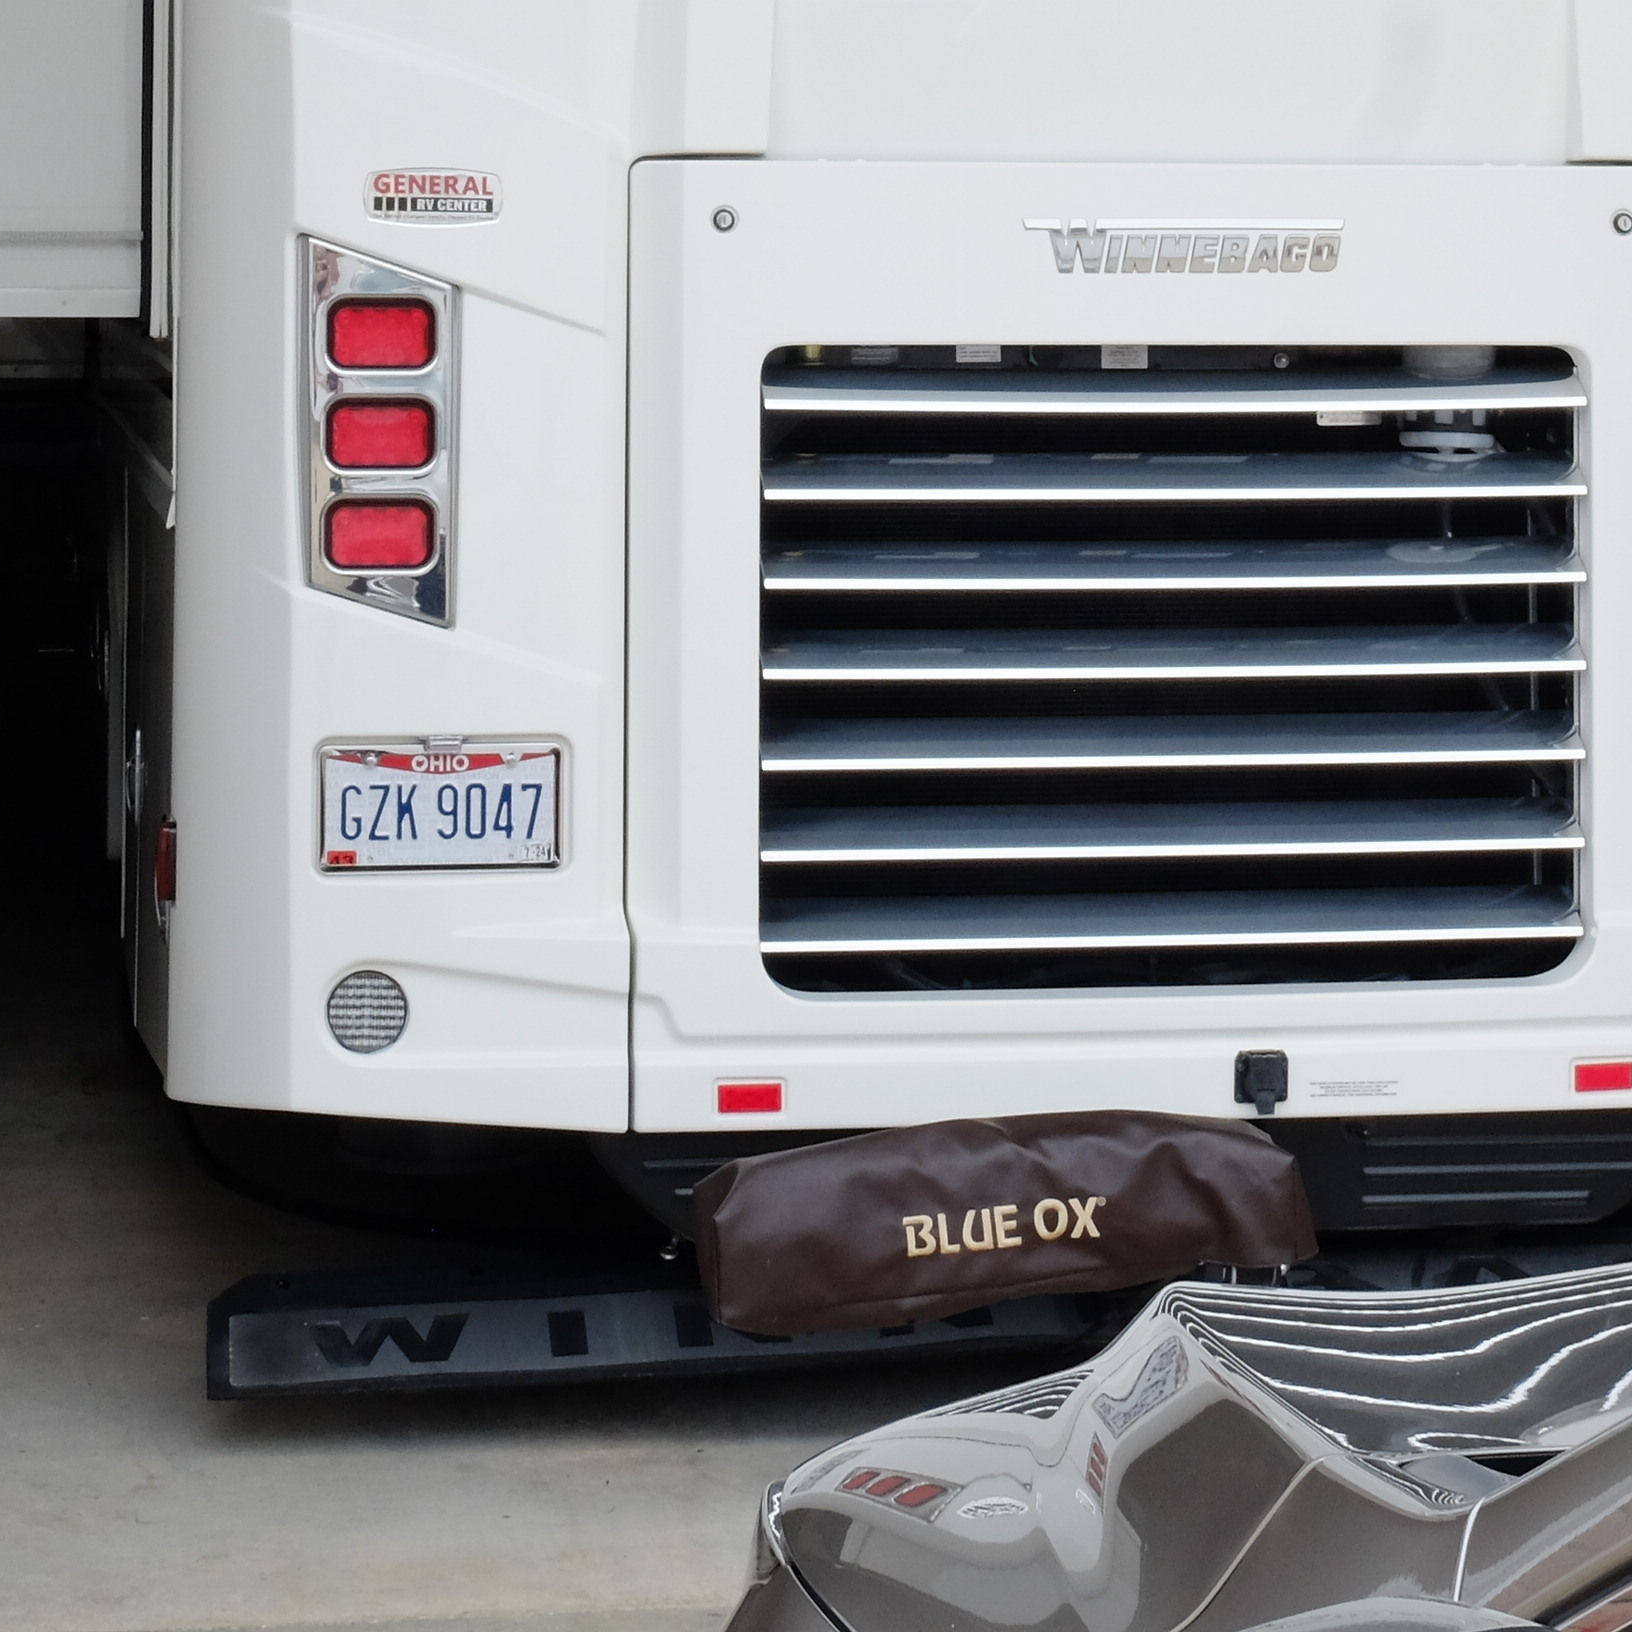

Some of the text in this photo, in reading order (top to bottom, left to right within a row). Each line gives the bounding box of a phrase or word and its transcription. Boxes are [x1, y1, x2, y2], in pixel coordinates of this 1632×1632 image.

[373, 173, 494, 196] GENERAL
[416, 198, 488, 212] RV CENTER
[1046, 218, 1342, 274] WINNEBAGO
[411, 754, 470, 773] OHIO
[340, 782, 543, 841] GZK 9047
[902, 1196, 1101, 1258] BLUE OX
